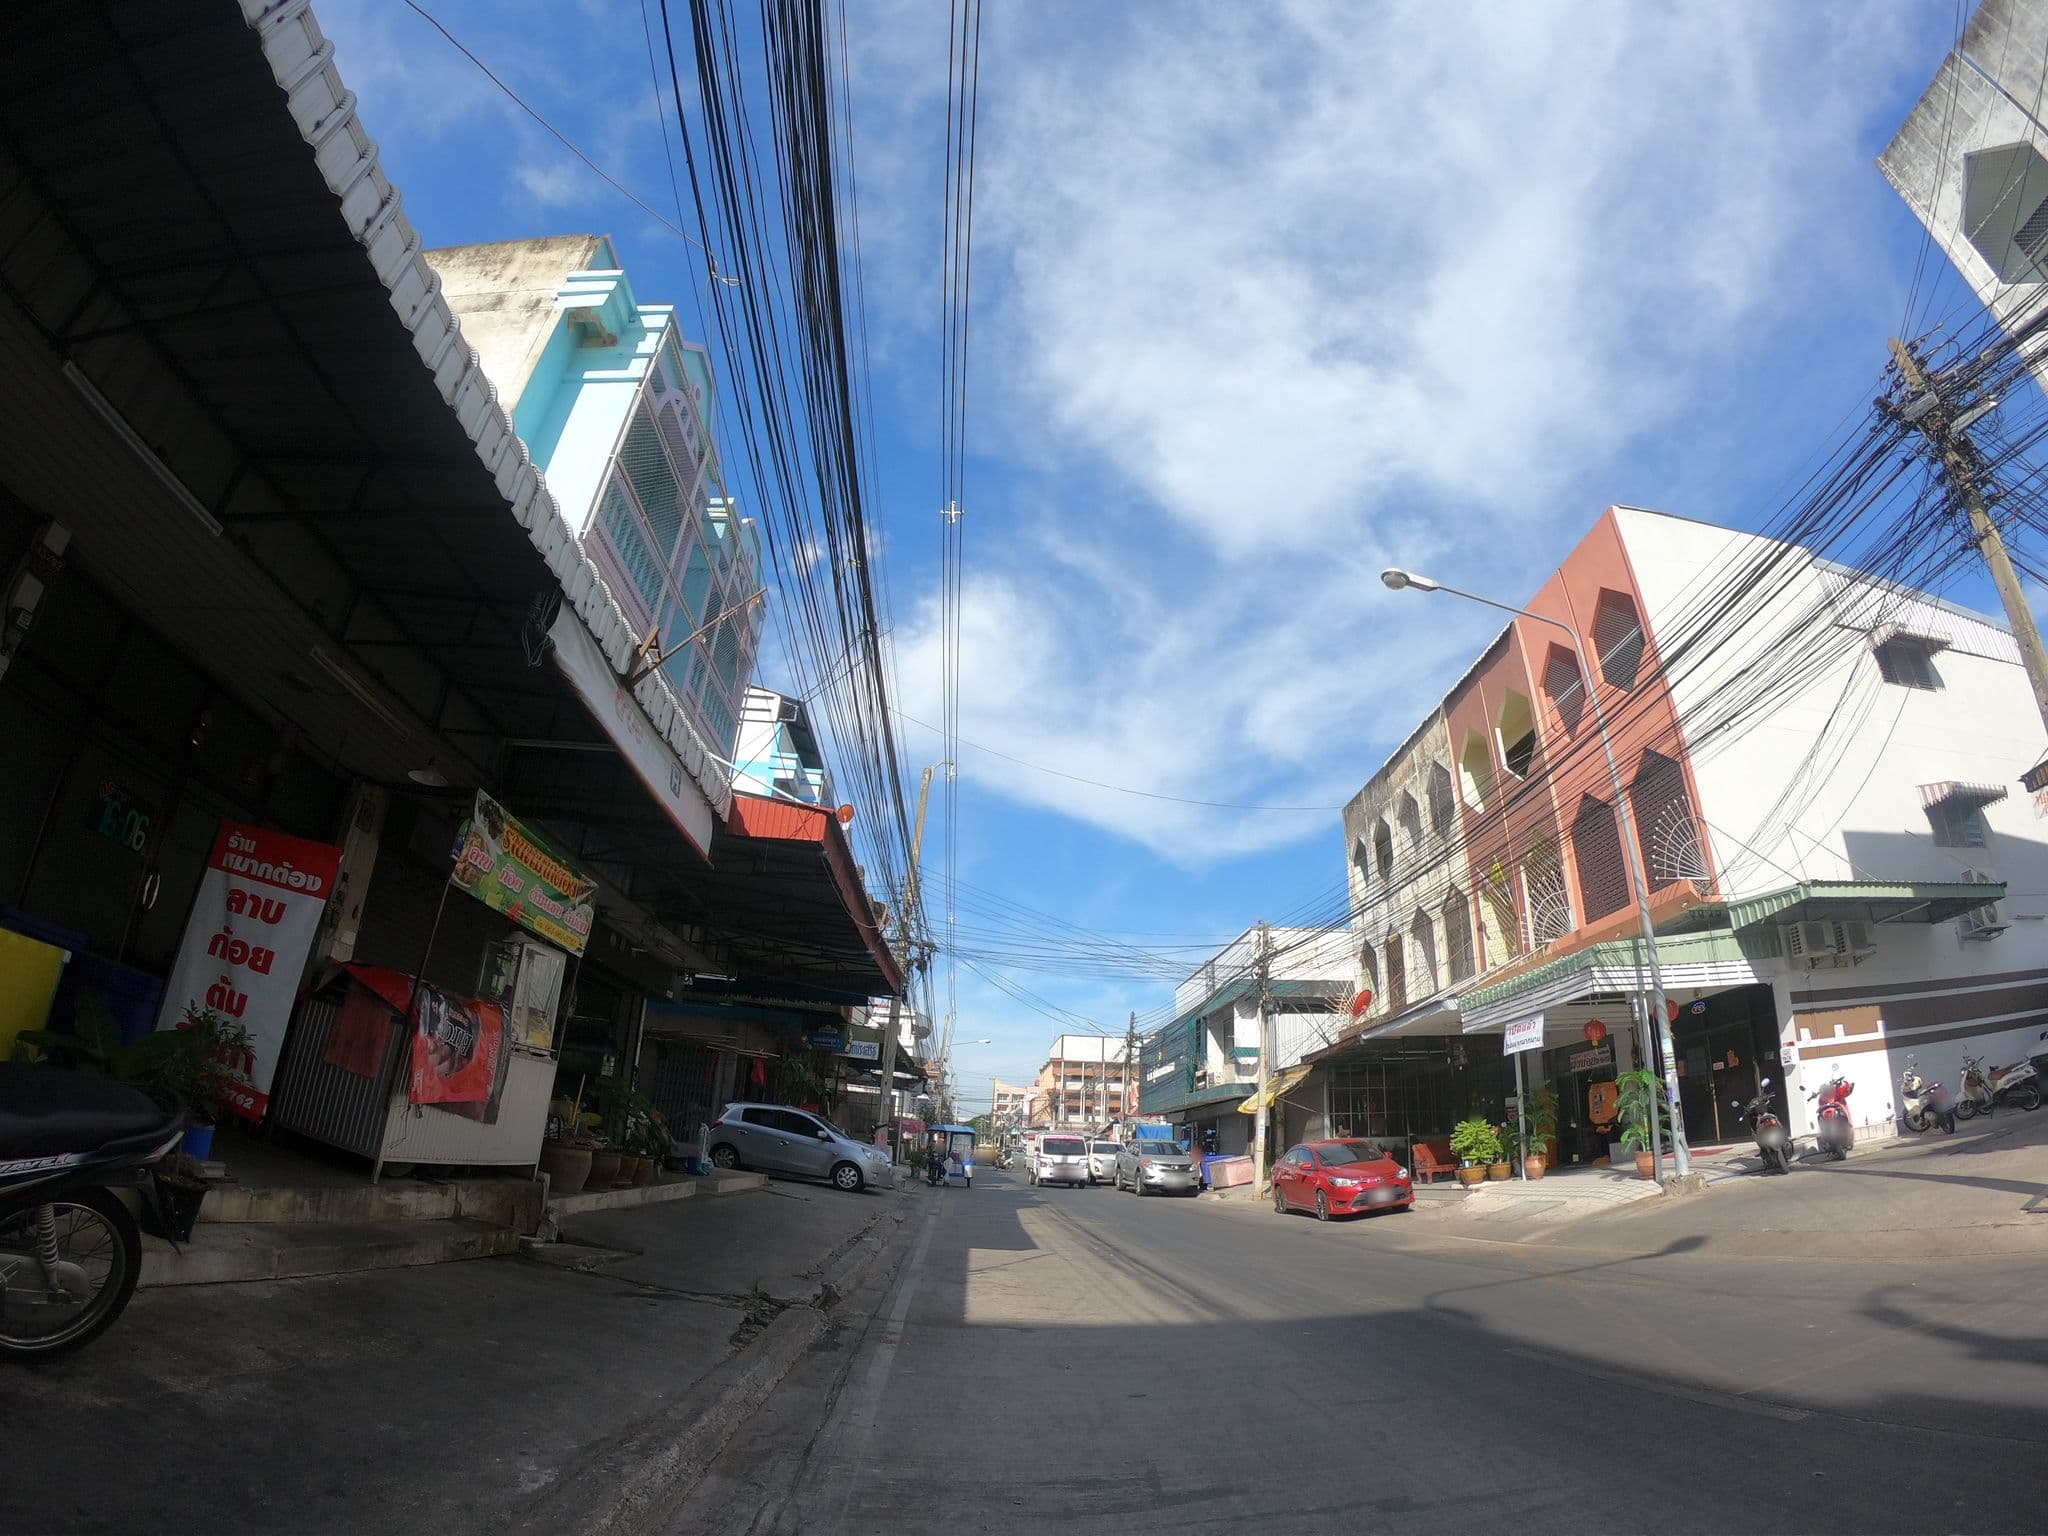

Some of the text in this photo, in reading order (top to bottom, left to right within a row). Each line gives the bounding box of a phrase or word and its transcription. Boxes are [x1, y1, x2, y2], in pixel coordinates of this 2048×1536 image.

[227, 831, 257, 854] ร้าน
[226, 887, 287, 925] ลาบ
[208, 925, 275, 975] ก้อย
[205, 974, 249, 1019] ต้ม
